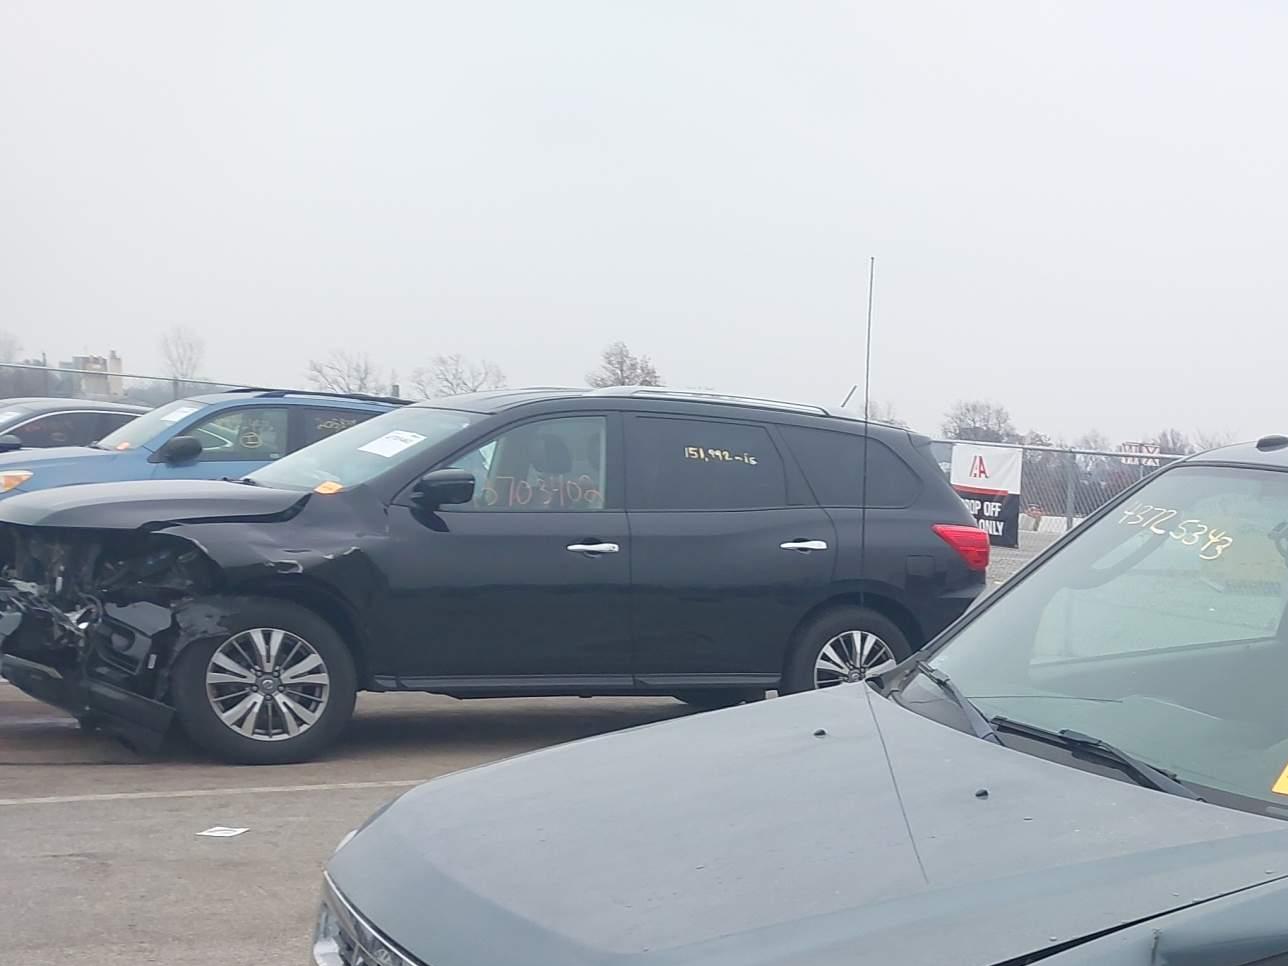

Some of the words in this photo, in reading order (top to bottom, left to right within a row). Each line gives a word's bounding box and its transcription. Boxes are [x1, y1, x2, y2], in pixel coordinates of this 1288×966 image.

[983, 501, 1002, 517] OFF
[978, 519, 1004, 536] ONLY
[1117, 502, 1233, 561] 43725343
